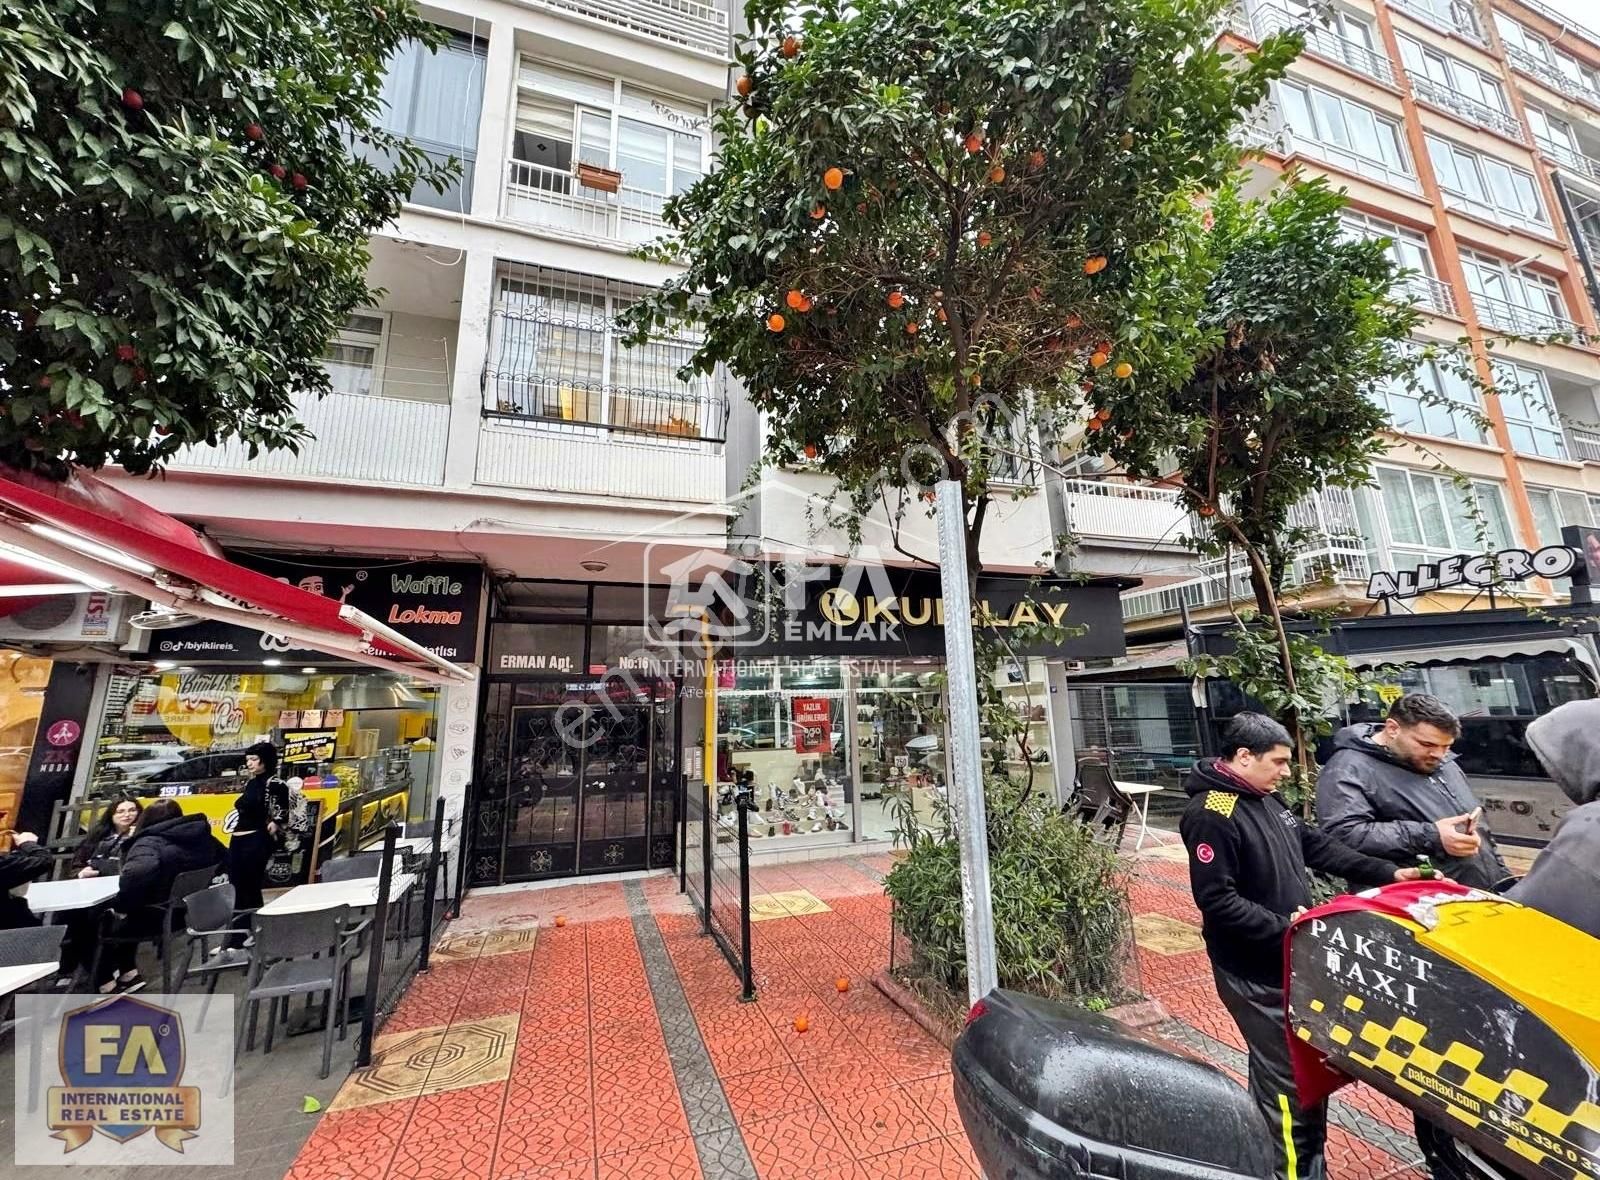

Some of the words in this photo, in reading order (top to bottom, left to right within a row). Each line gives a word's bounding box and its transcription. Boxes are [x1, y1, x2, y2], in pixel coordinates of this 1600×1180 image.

[1367, 545, 1578, 599] ALLEGRO
[391, 574, 462, 595] Waffle
[388, 604, 461, 625] Lokma
[866, 596, 1069, 627] KUILAY
[500, 655, 546, 669] ERMAN
[549, 655, 574, 671] Apt.
[619, 657, 649, 669] No:16
[159, 786, 178, 796] 199
[1310, 918, 1433, 982] PAKET
[1407, 1067, 1481, 1114] pakettaxi.com
[1532, 1132, 1564, 1155] 336
[1566, 1149, 1578, 1162] 0
